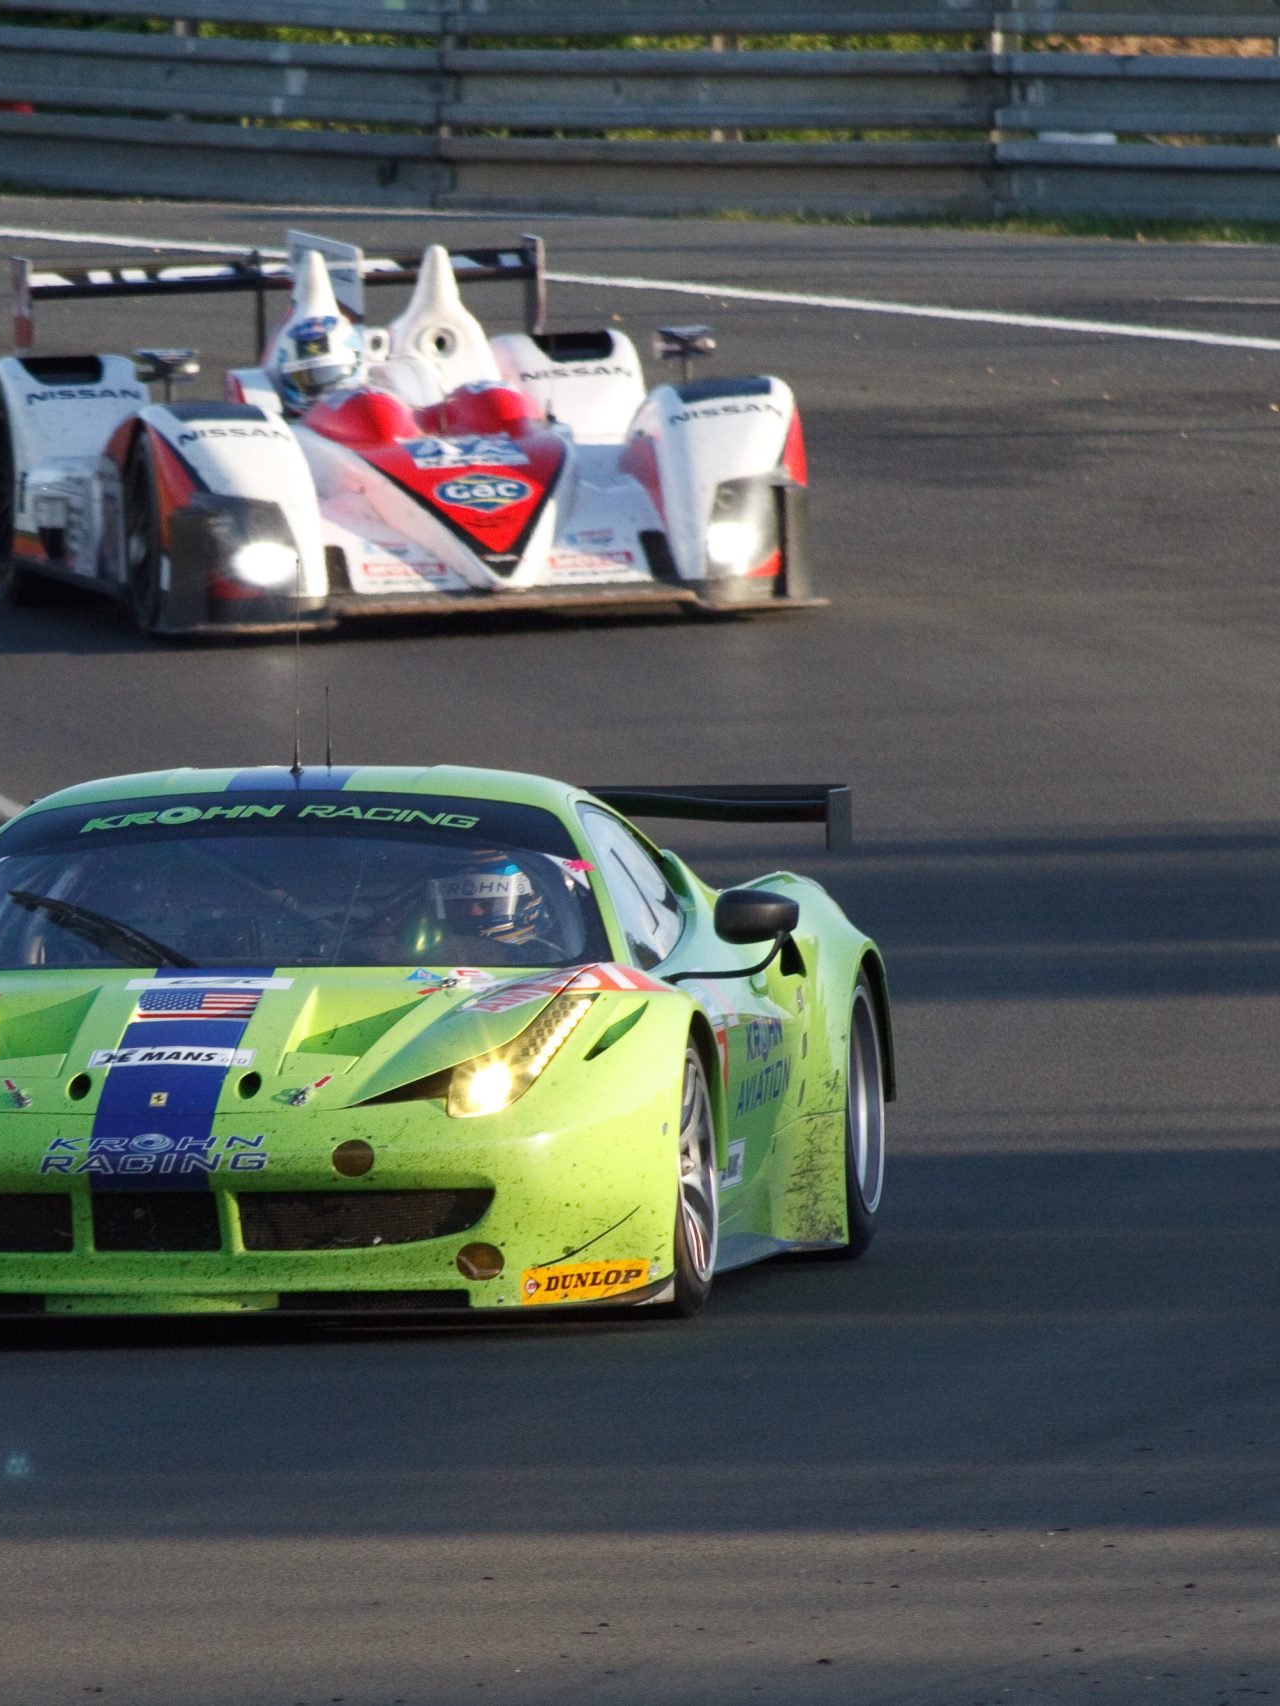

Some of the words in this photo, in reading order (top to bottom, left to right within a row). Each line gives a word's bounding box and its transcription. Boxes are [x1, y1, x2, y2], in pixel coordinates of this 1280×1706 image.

[520, 365, 632, 382] NISSAN
[25, 388, 141, 406] NISSAN
[667, 403, 783, 425] NISSAN
[178, 427, 291, 446] NISSAN
[79, 804, 285, 833] KROHN
[298, 804, 480, 830] RACING
[139, 1050, 218, 1062] MANS
[735, 1056, 792, 1119] AVIATION
[46, 1132, 265, 1154] KROHN
[39, 1153, 268, 1174] RACING
[544, 1269, 642, 1291] DUNLOP
